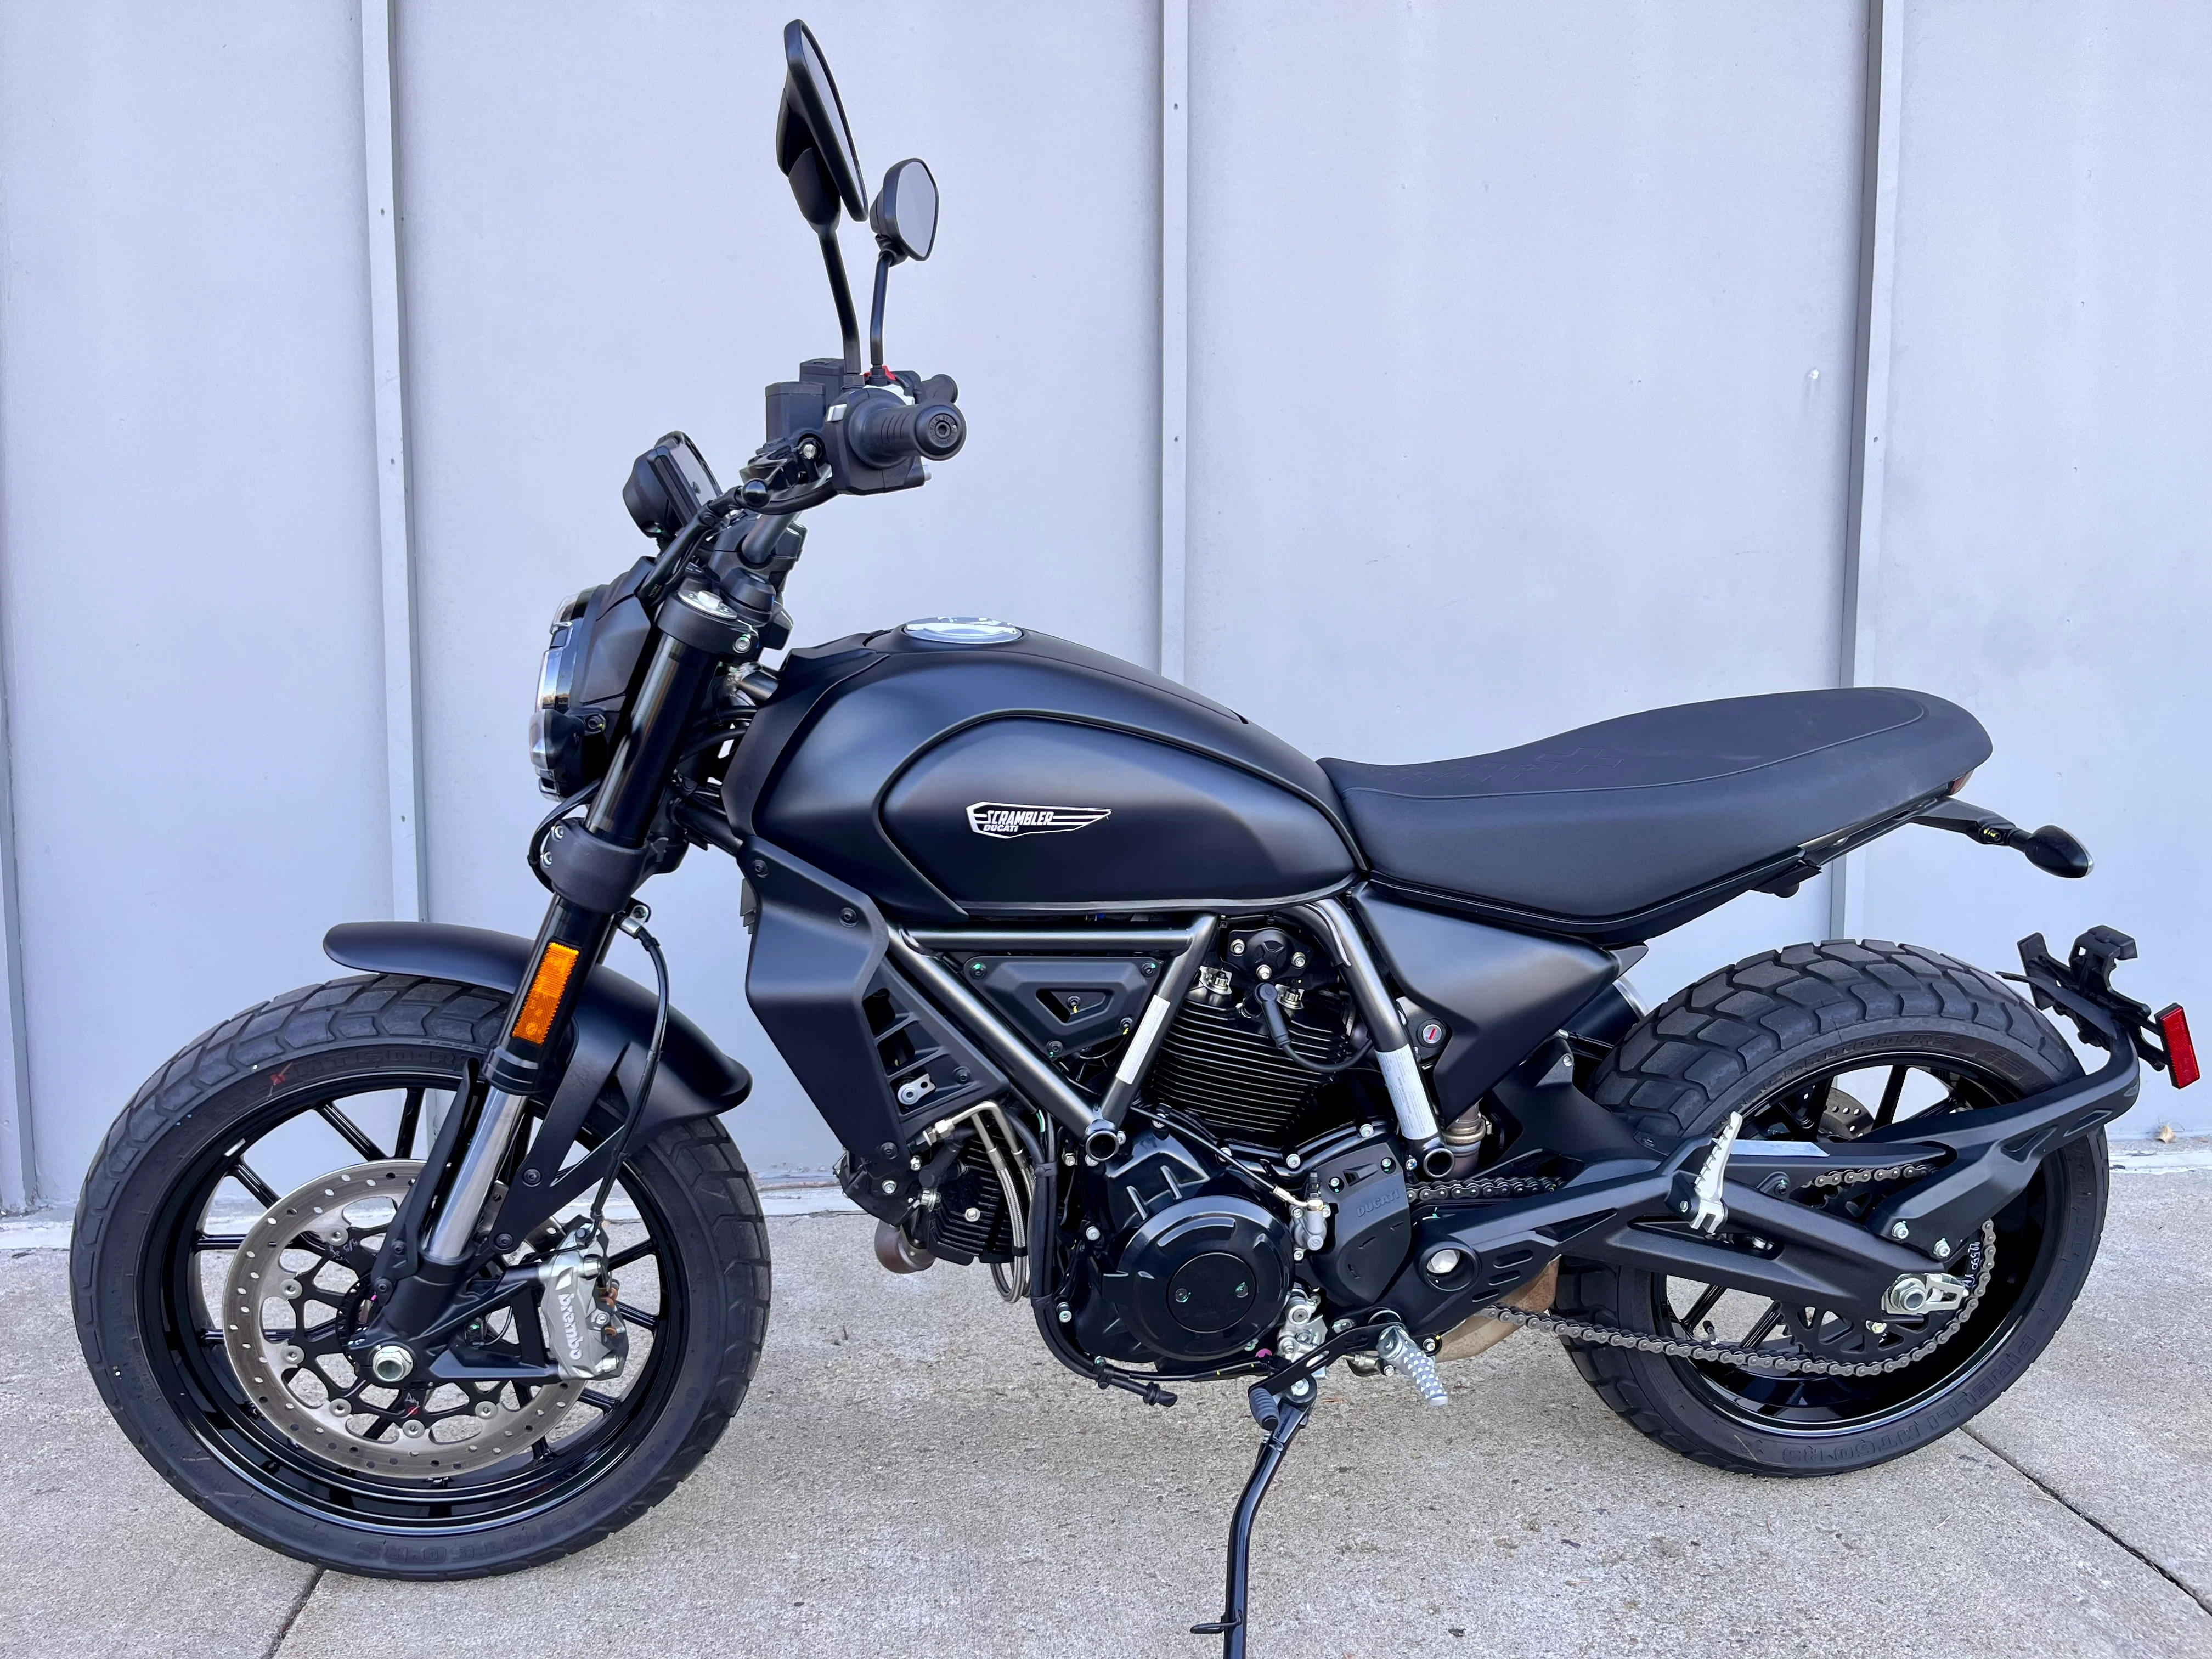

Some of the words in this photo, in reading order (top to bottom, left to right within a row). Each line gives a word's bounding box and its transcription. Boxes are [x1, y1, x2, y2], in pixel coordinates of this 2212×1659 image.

[983, 824, 1019, 832] DUCATI
[987, 810, 1054, 826] SCRAMBLER
[1357, 1189, 1401, 1217] DUCATI
[558, 1293, 584, 1361] brembo
[1927, 1334, 2037, 1430] PIRELLI
[1833, 1423, 1921, 1460] MT60
